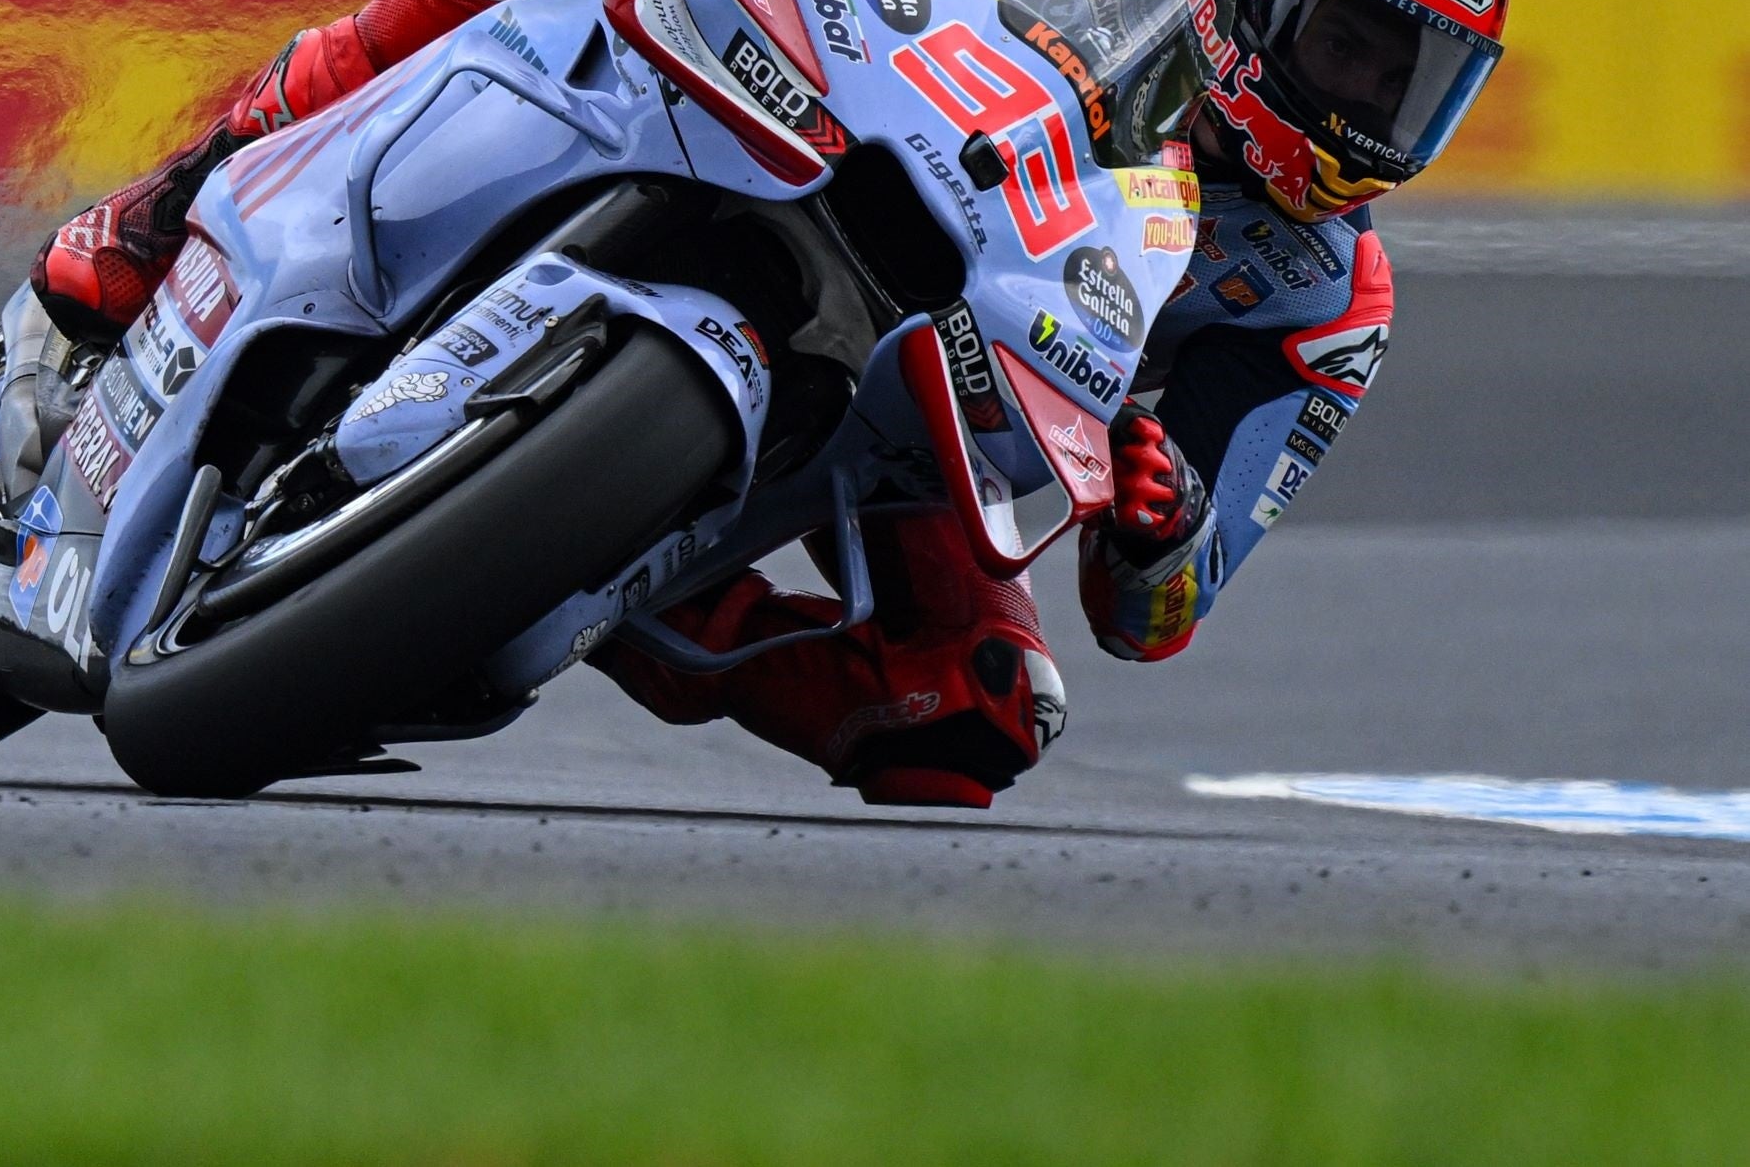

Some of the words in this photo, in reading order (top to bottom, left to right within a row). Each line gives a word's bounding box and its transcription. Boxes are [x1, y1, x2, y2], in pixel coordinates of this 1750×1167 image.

[1426, 10, 1461, 37] YOU
[728, 60, 798, 129] RIDERS
[734, 41, 811, 118] BOLD
[1025, 20, 1112, 141] Kapriol
[890, 21, 1098, 262] 93
[1346, 127, 1409, 165] VERTICAL
[903, 132, 990, 256] Gigetta
[174, 236, 226, 323] ASPIRA
[1077, 256, 1134, 318] Estrella
[1241, 218, 1316, 291] Unibat
[1077, 282, 1131, 337] Galicia
[938, 319, 969, 397] RIDERS
[946, 308, 992, 395] BOLD
[1028, 305, 1124, 406] Unibat
[1051, 431, 1088, 465] FEDERAL
[1087, 457, 1106, 476] OIL
